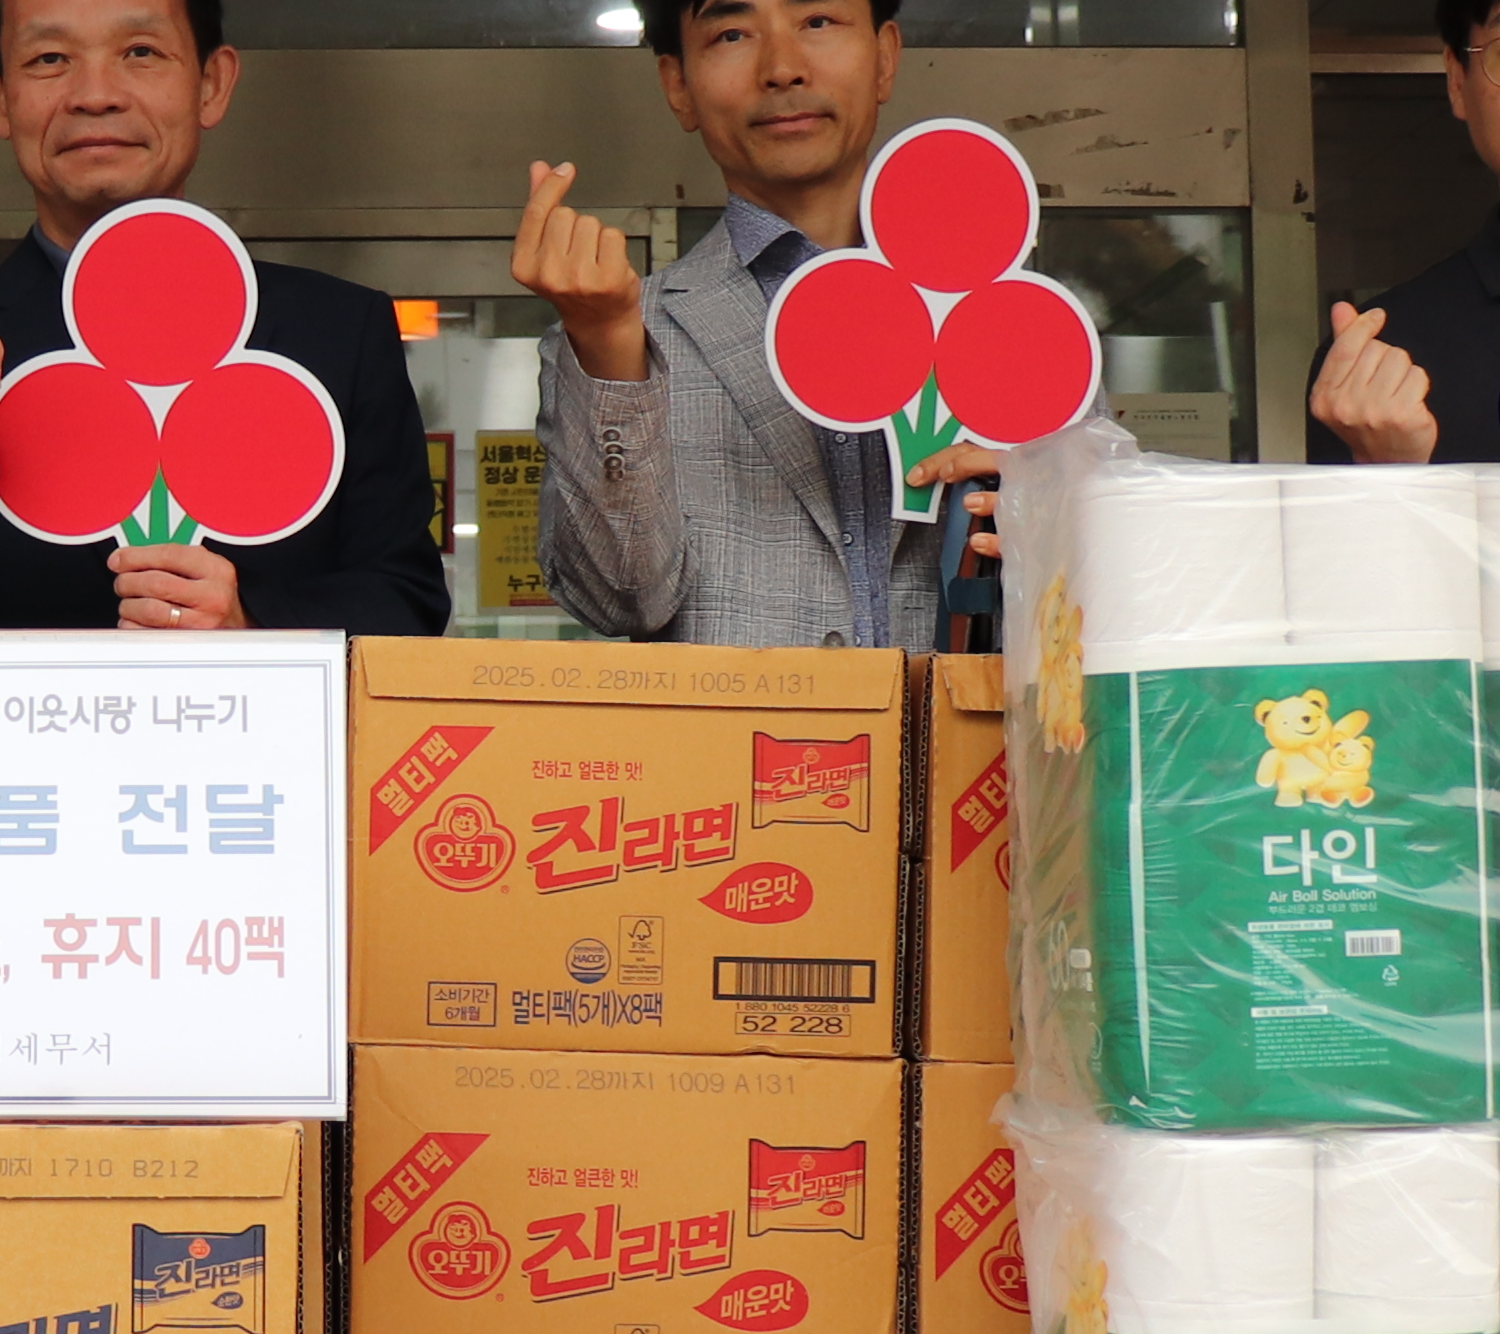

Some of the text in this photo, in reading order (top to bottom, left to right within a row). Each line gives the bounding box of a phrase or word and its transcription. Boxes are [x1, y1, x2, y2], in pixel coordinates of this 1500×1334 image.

[484, 466, 518, 484] 정상
[689, 672, 746, 694] 1005
[3, 693, 137, 735] 이웃사랑
[152, 694, 248, 733] 나누기
[376, 732, 459, 817] 멀티팩
[532, 760, 643, 781] 진하고 얼큰한 맛!
[770, 764, 852, 801] 진라면
[118, 782, 285, 856] 전달
[433, 841, 498, 868] 오뚜기
[527, 796, 739, 895] 진라면
[1262, 826, 1378, 887] 다인
[725, 872, 800, 913] 매운맛
[1268, 891, 1288, 903] Air
[1322, 889, 1376, 901] Solution
[40, 912, 162, 980] 휴지
[185, 915, 286, 980] 40팩
[572, 953, 605, 964] HACCP
[434, 989, 491, 1004] 소비기간
[745, 1002, 768, 1012] 880
[771, 1003, 799, 1012] 1045
[445, 1006, 481, 1021] 6개월
[742, 1015, 843, 1034] 52 228
[667, 1071, 724, 1094] 1009
[50, 1158, 113, 1178] 1710
[133, 1160, 200, 1179] B212
[371, 1139, 454, 1225] 멀티팩
[527, 1167, 639, 1189] 진하고 얼큰한 맛!
[766, 1171, 846, 1209] 진라면
[941, 1155, 1015, 1241] 멀티팩
[428, 1248, 492, 1276] 오뚜기
[521, 1204, 734, 1303] 진라면
[154, 1259, 243, 1298] 진라면
[720, 1279, 794, 1321] 매운맛
